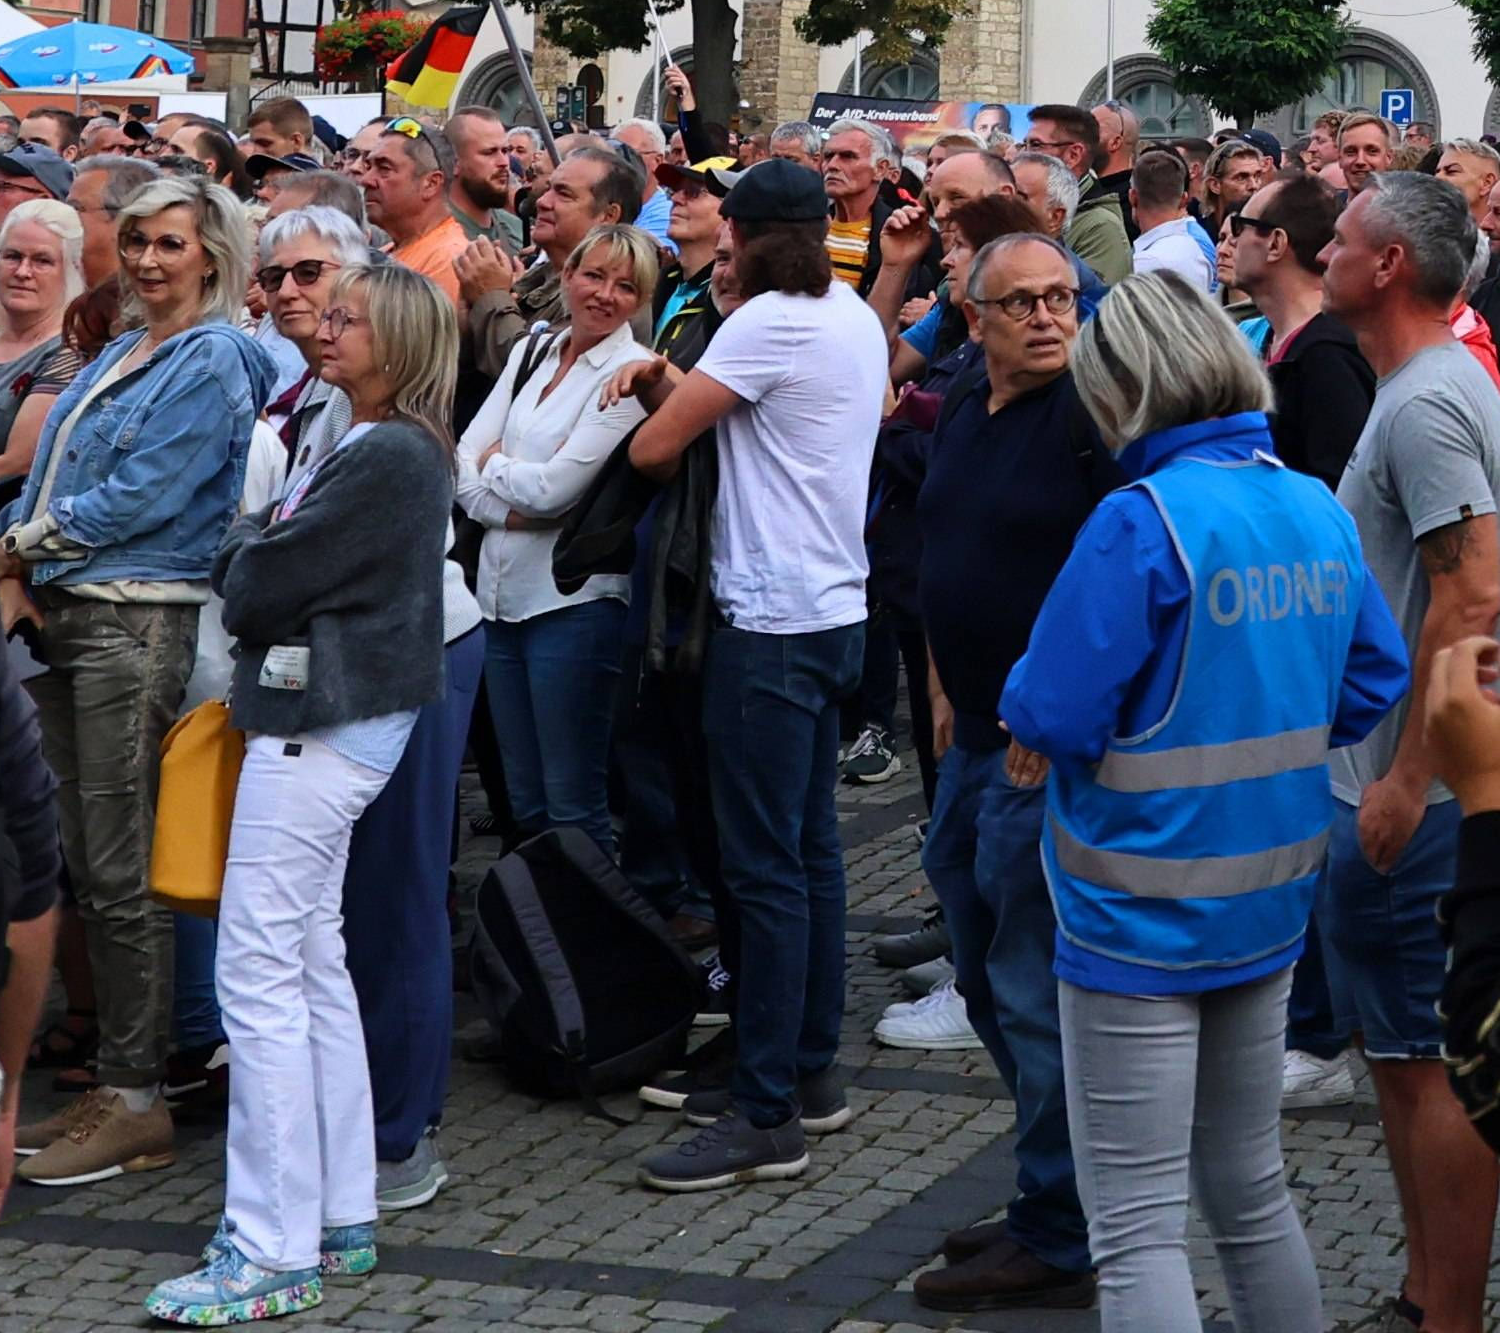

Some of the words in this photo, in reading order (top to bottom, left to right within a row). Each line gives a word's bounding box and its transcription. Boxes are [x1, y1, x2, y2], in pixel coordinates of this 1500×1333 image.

[815, 107, 836, 118] Der
[1387, 94, 1405, 122] P
[1207, 559, 1350, 627] ORDNER
